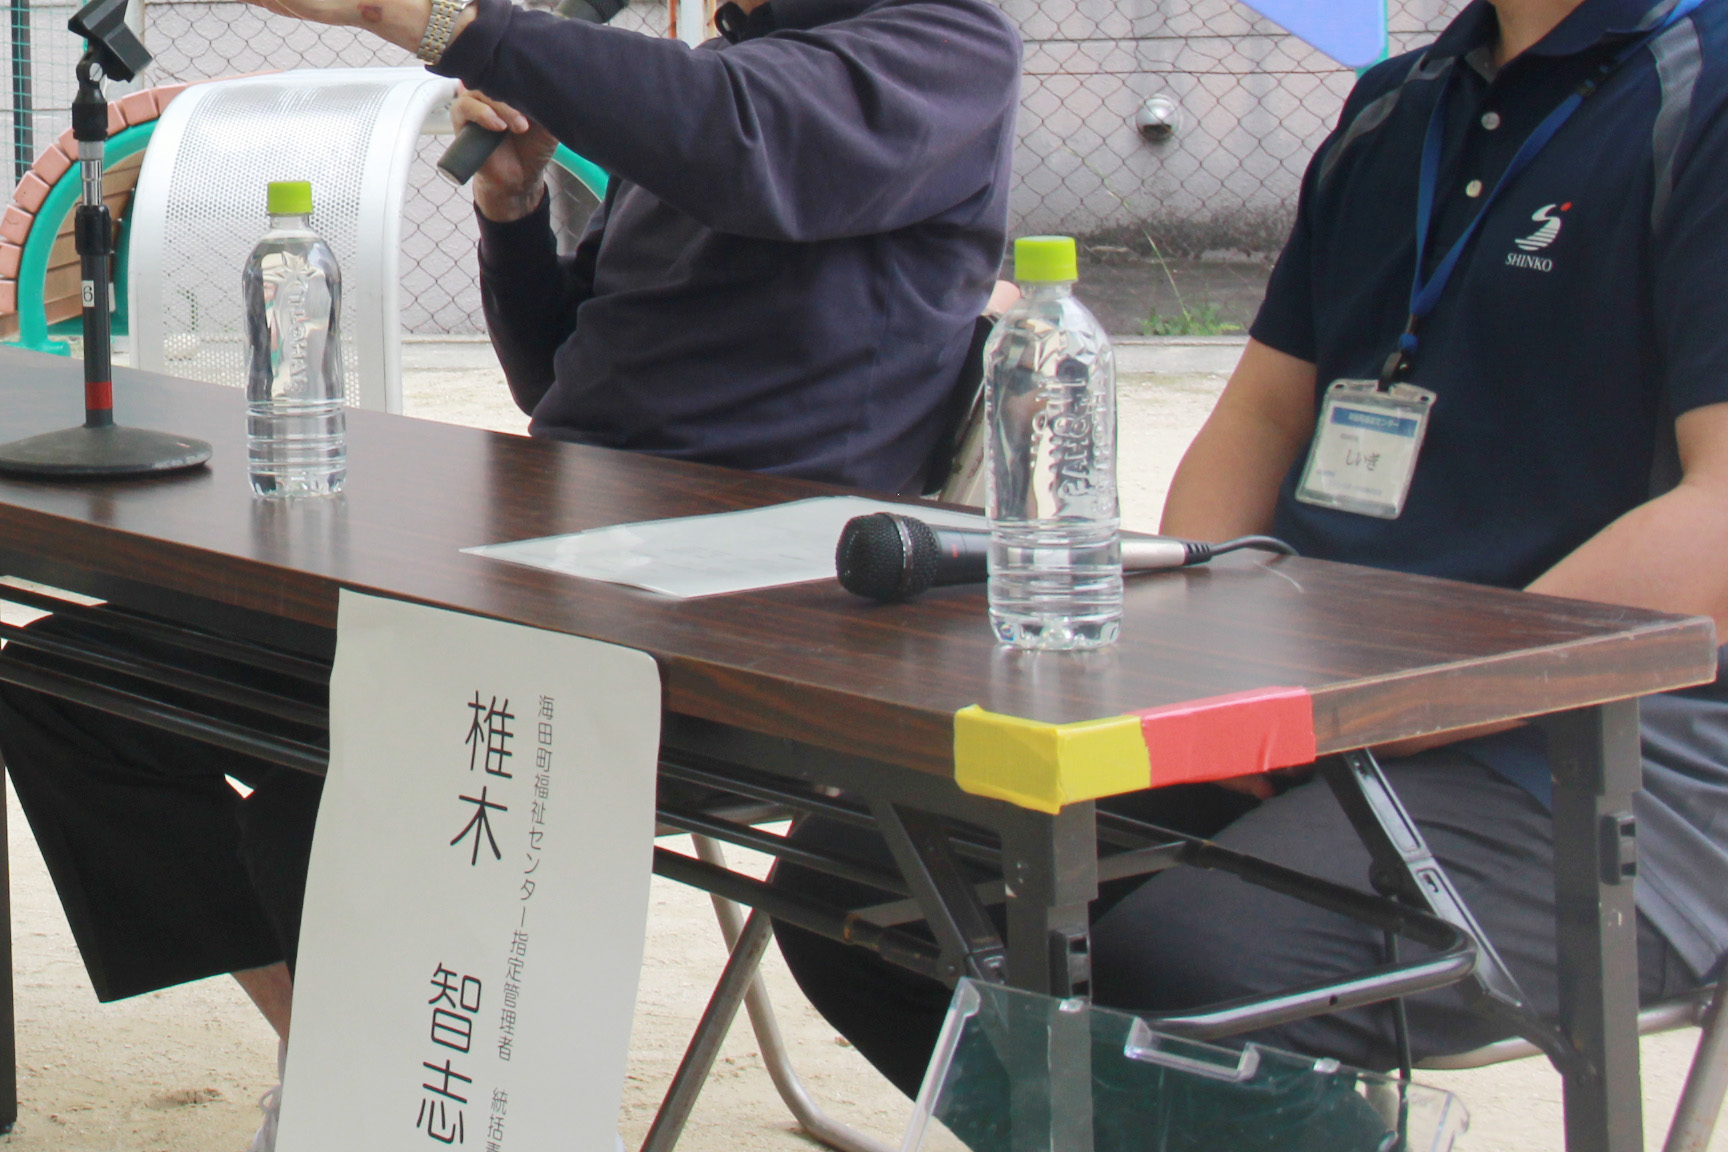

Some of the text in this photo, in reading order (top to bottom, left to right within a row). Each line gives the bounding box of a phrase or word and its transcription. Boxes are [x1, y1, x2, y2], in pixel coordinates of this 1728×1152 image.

[83, 285, 93, 302] 6
[1505, 253, 1553, 272] SHINKO
[449, 690, 515, 866] 椎木
[498, 694, 556, 1062] 海田町福祉センター指定管理者
